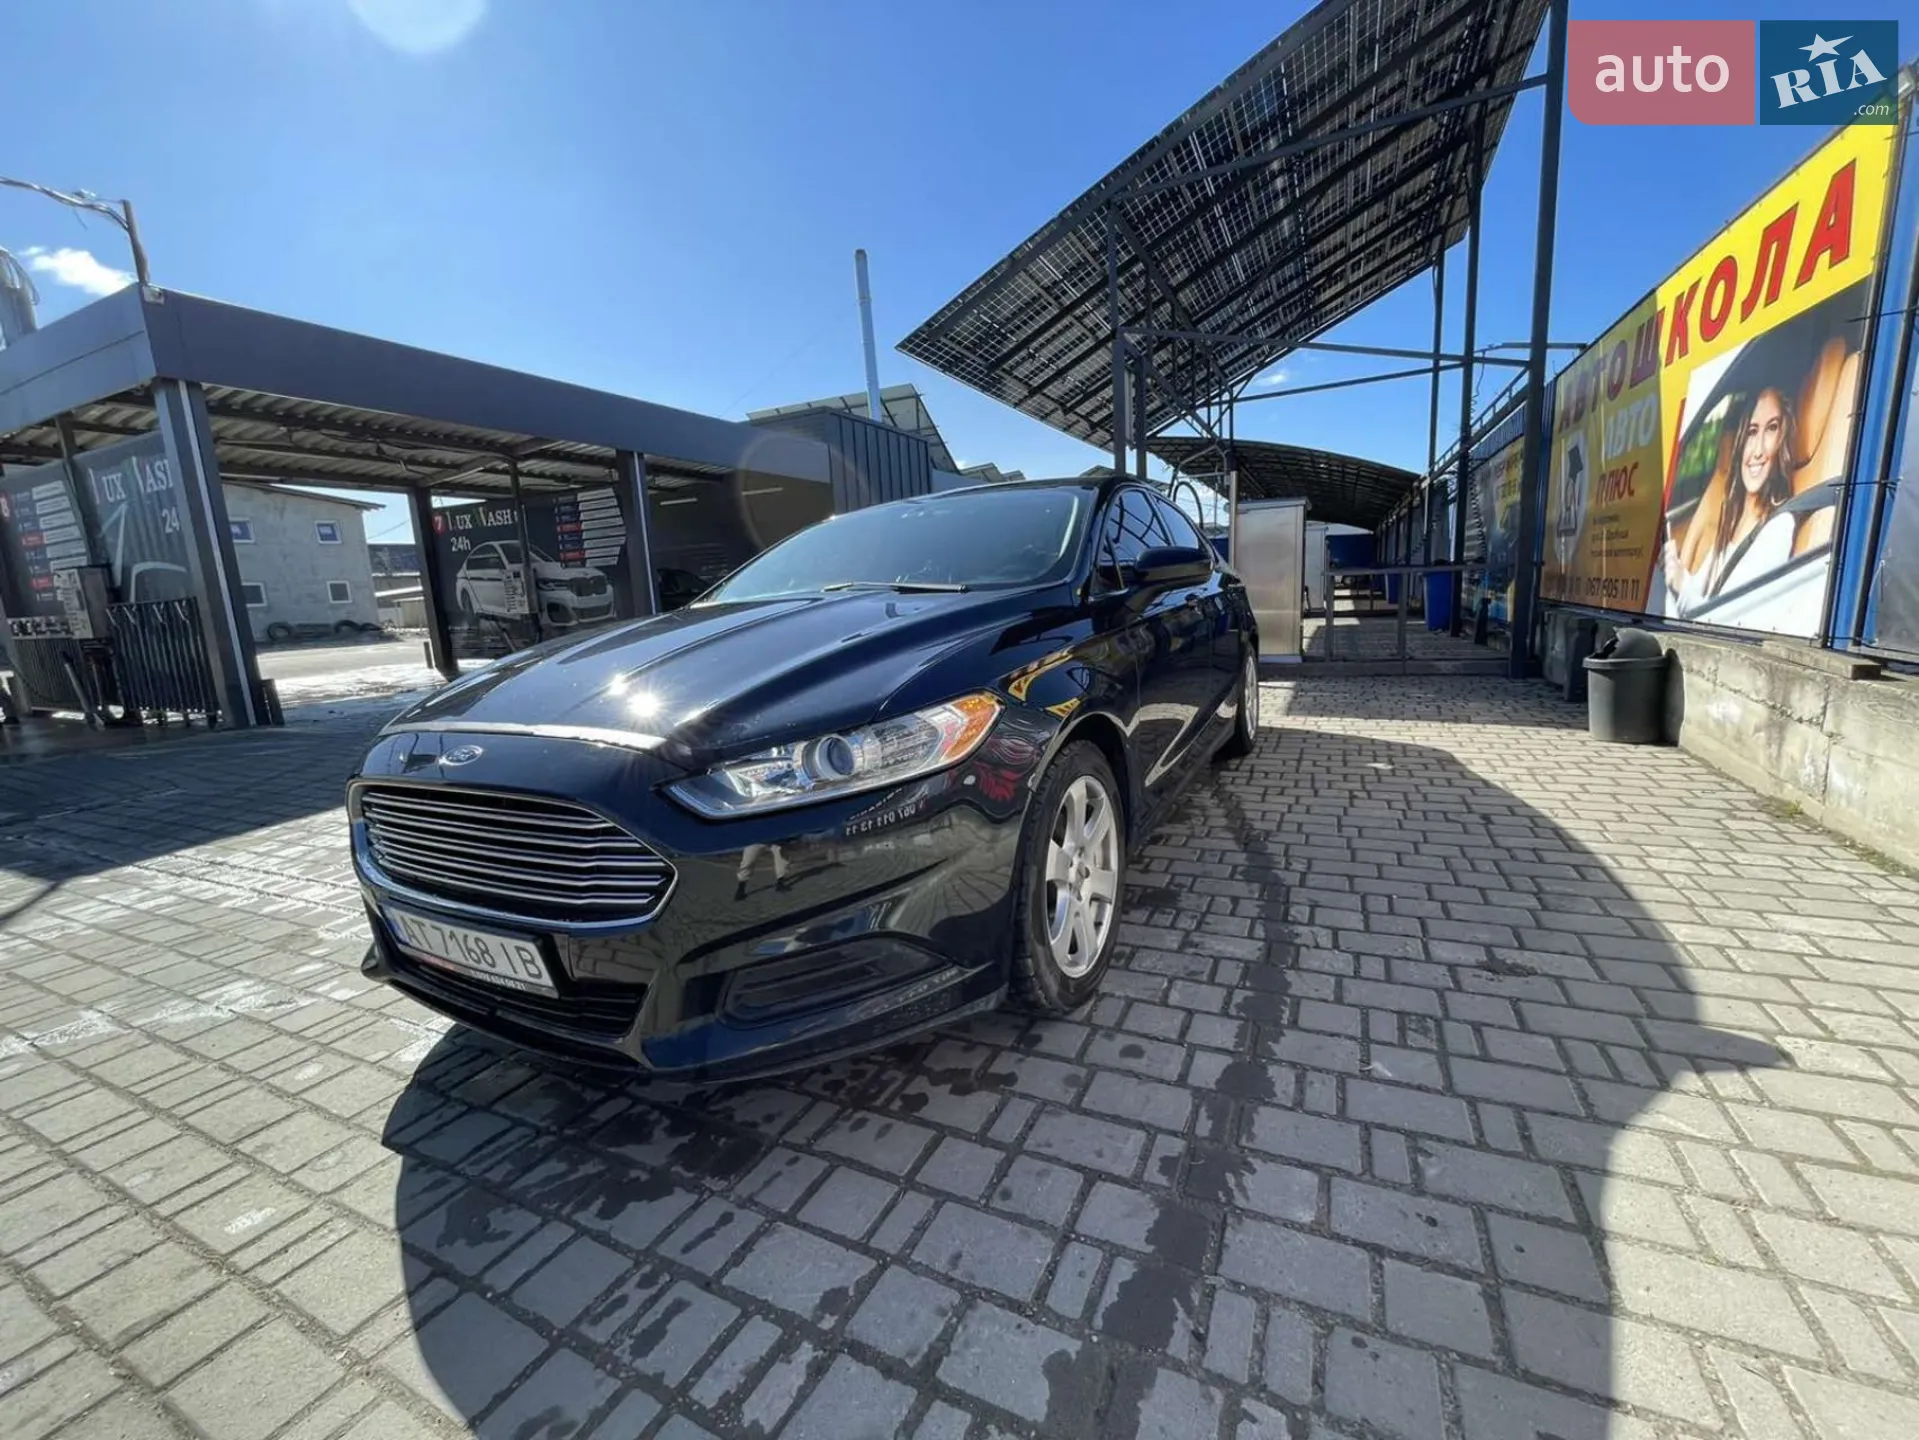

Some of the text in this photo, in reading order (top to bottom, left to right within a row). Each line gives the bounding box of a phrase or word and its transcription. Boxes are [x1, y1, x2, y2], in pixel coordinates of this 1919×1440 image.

[1557, 158, 1857, 434] АВТОШКОЛА
[1606, 393, 1659, 460] АВТО
[450, 535, 471, 552] 24h
[401, 911, 543, 980] AT 7168 IB
